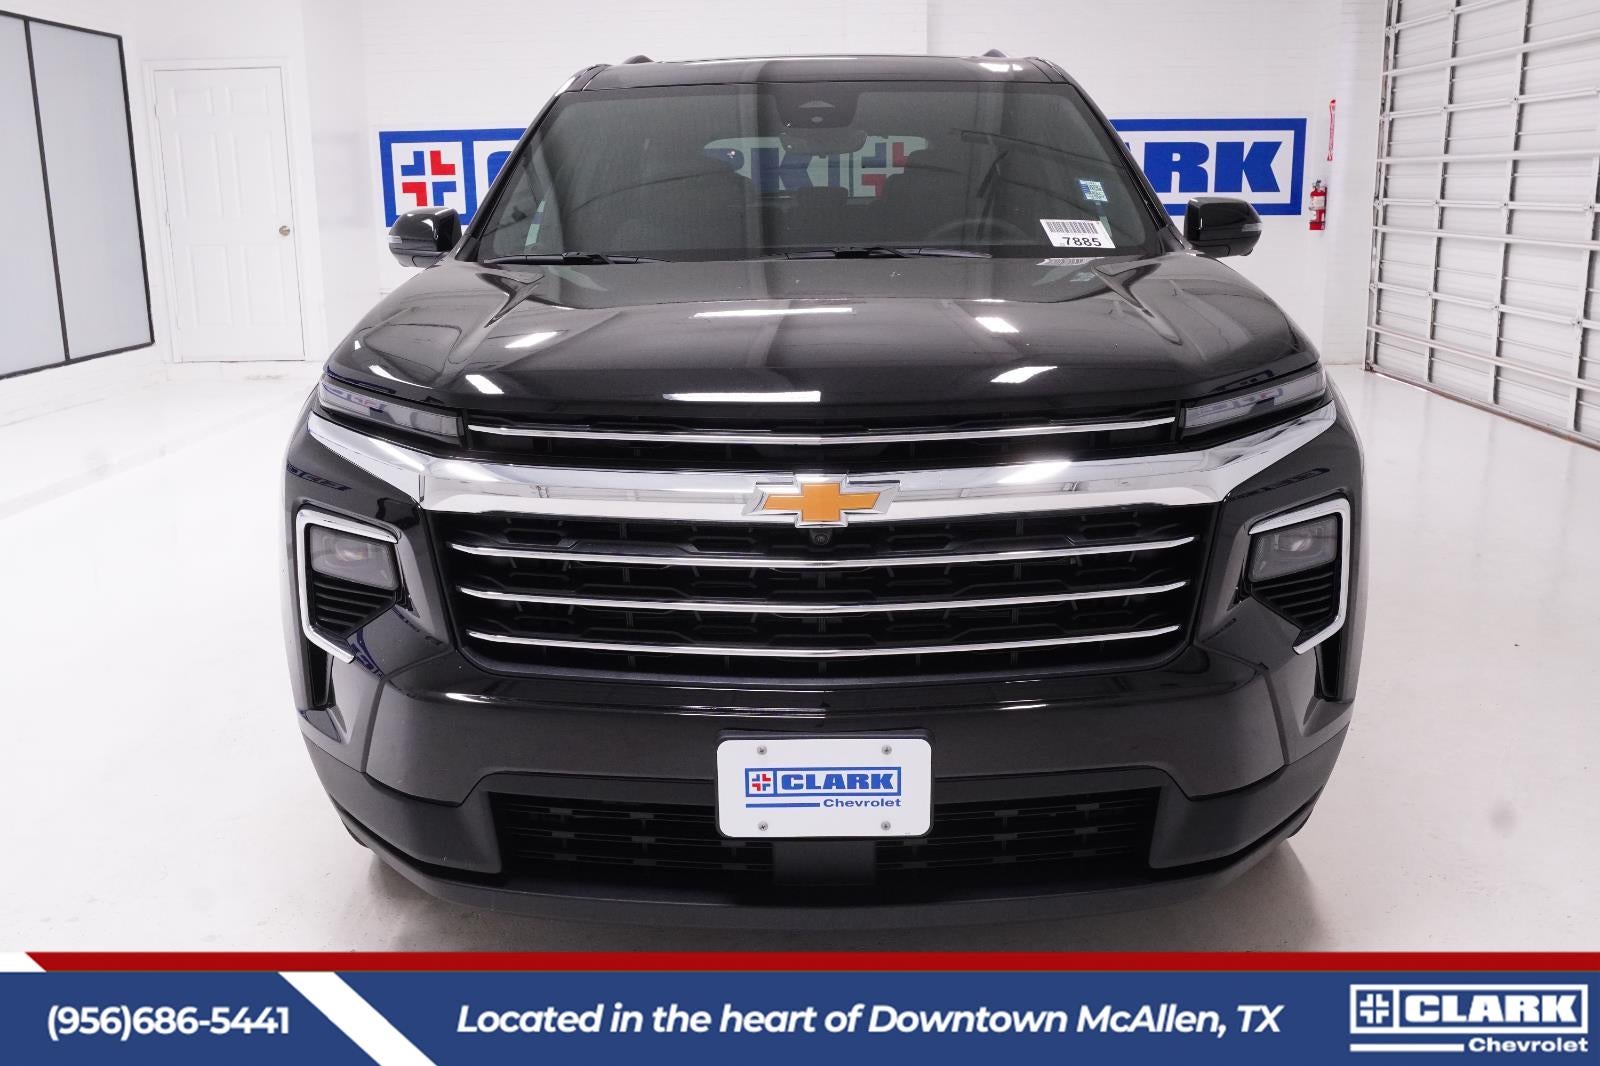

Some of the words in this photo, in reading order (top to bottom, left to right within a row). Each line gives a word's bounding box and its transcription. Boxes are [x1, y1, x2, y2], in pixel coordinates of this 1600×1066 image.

[1061, 236, 1103, 248] 7885
[780, 773, 894, 790] CLARK
[823, 798, 902, 808] Chevrolet
